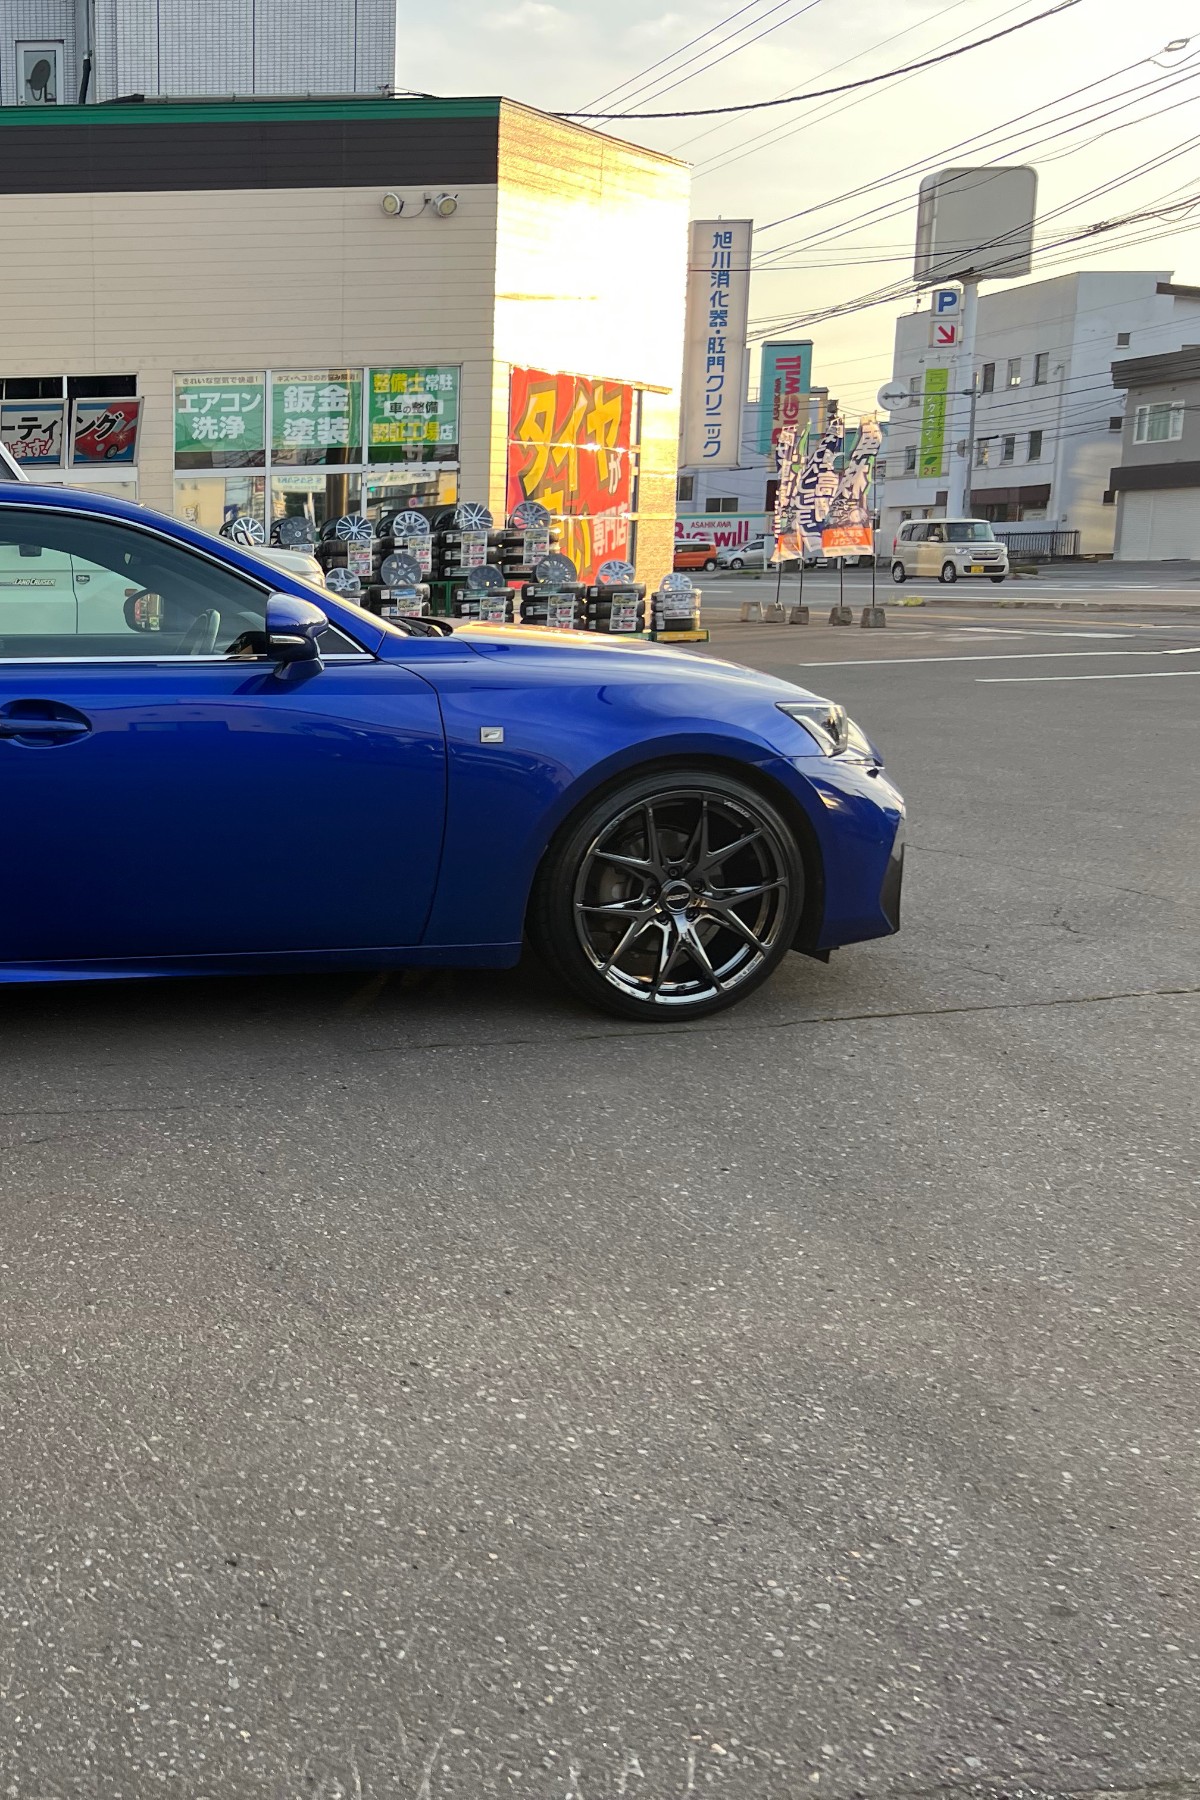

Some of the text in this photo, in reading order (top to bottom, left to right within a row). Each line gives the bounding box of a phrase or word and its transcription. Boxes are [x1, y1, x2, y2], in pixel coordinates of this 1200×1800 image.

[938, 291, 958, 313] P
[703, 230, 733, 459] 旭川消化器・肛門クリニック
[178, 392, 262, 414] エアコン
[283, 384, 350, 413] 鈑金
[389, 401, 438, 414] 車の整備
[191, 415, 246, 440] 洗浄
[283, 416, 350, 445] 塗装
[691, 521, 731, 529] ASAHIKAWA
